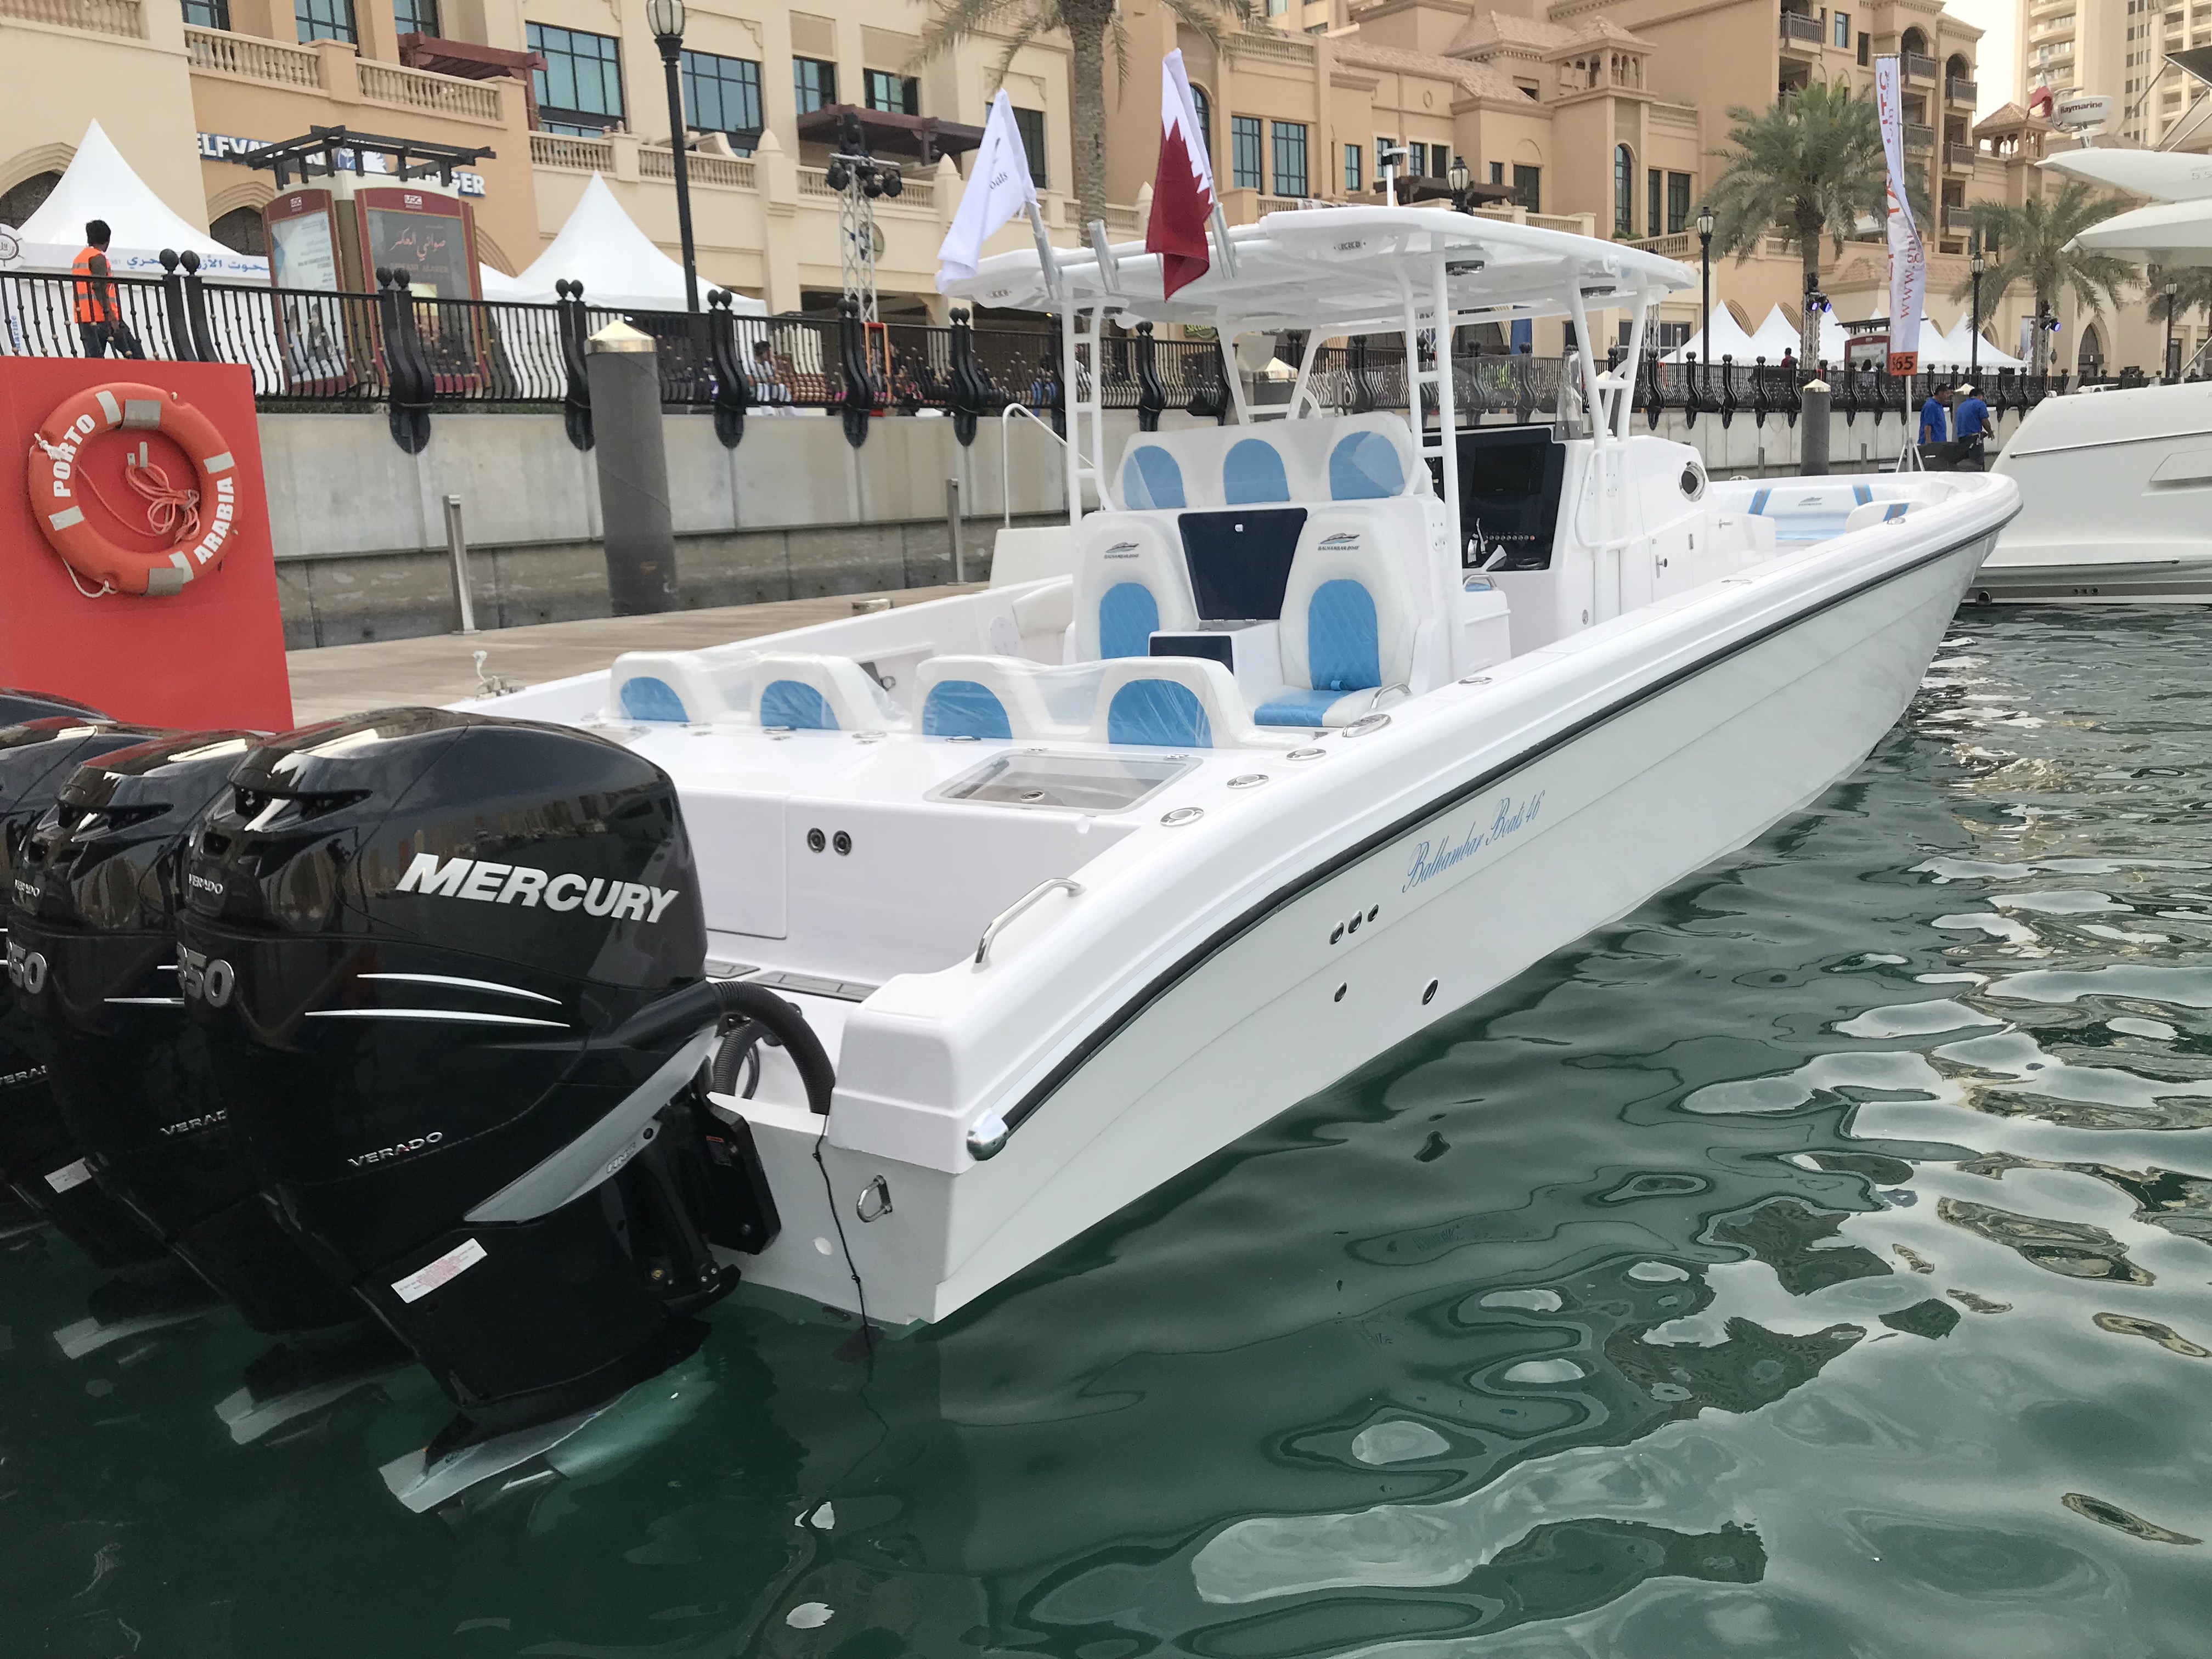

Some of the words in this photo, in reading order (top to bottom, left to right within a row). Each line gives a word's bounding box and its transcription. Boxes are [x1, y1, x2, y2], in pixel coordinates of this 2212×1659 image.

[2061, 101, 2103, 114] Raymarine
[197, 133, 326, 166] ELEVAN
[989, 171, 1008, 189] oats
[53, 414, 96, 498] PORTO
[193, 476, 235, 565] ARABIA
[395, 852, 680, 923] MERCURY
[160, 1109, 227, 1135] VERAD
[347, 1131, 443, 1167] VERADO
